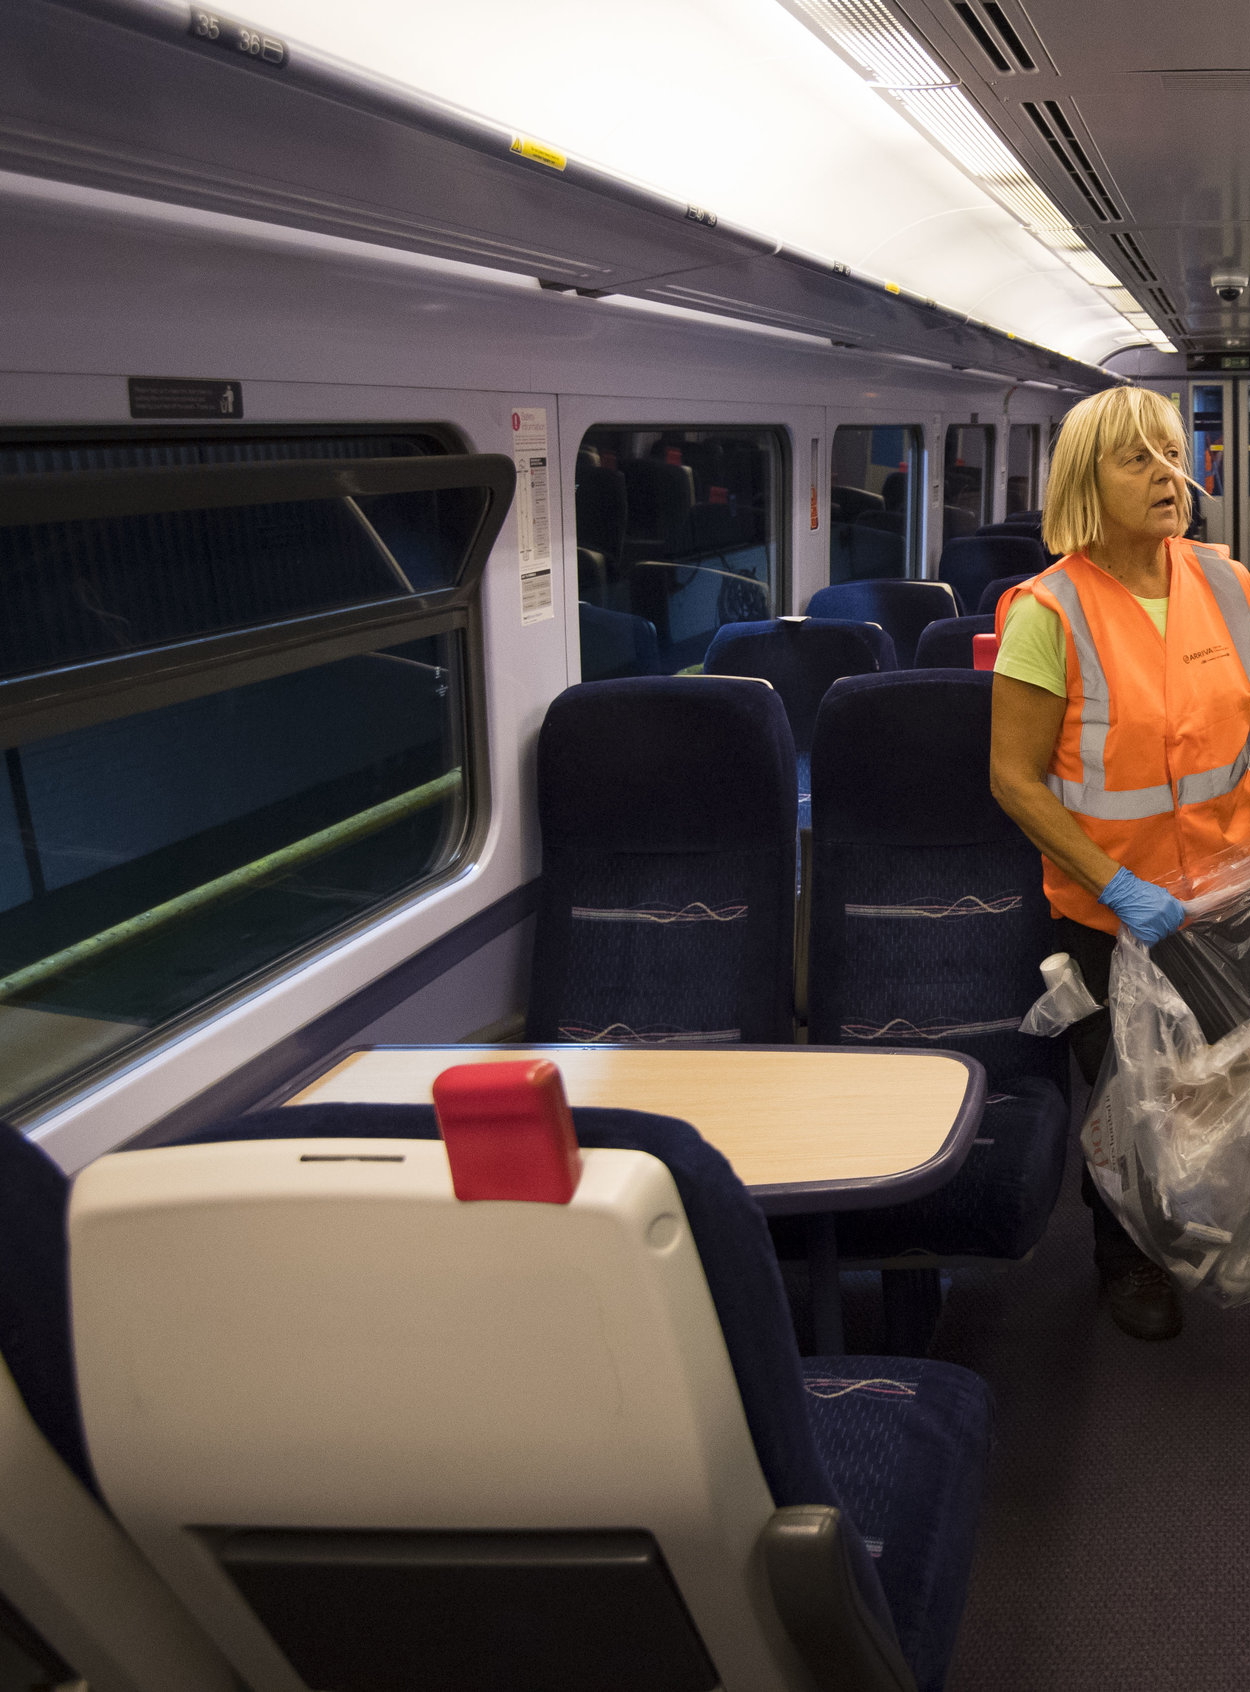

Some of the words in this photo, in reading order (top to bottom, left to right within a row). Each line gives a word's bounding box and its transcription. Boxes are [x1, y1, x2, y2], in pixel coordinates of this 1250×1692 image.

[198, 14, 219, 40] 35
[240, 30, 260, 55] 36
[1189, 647, 1214, 661] ARRIVA
